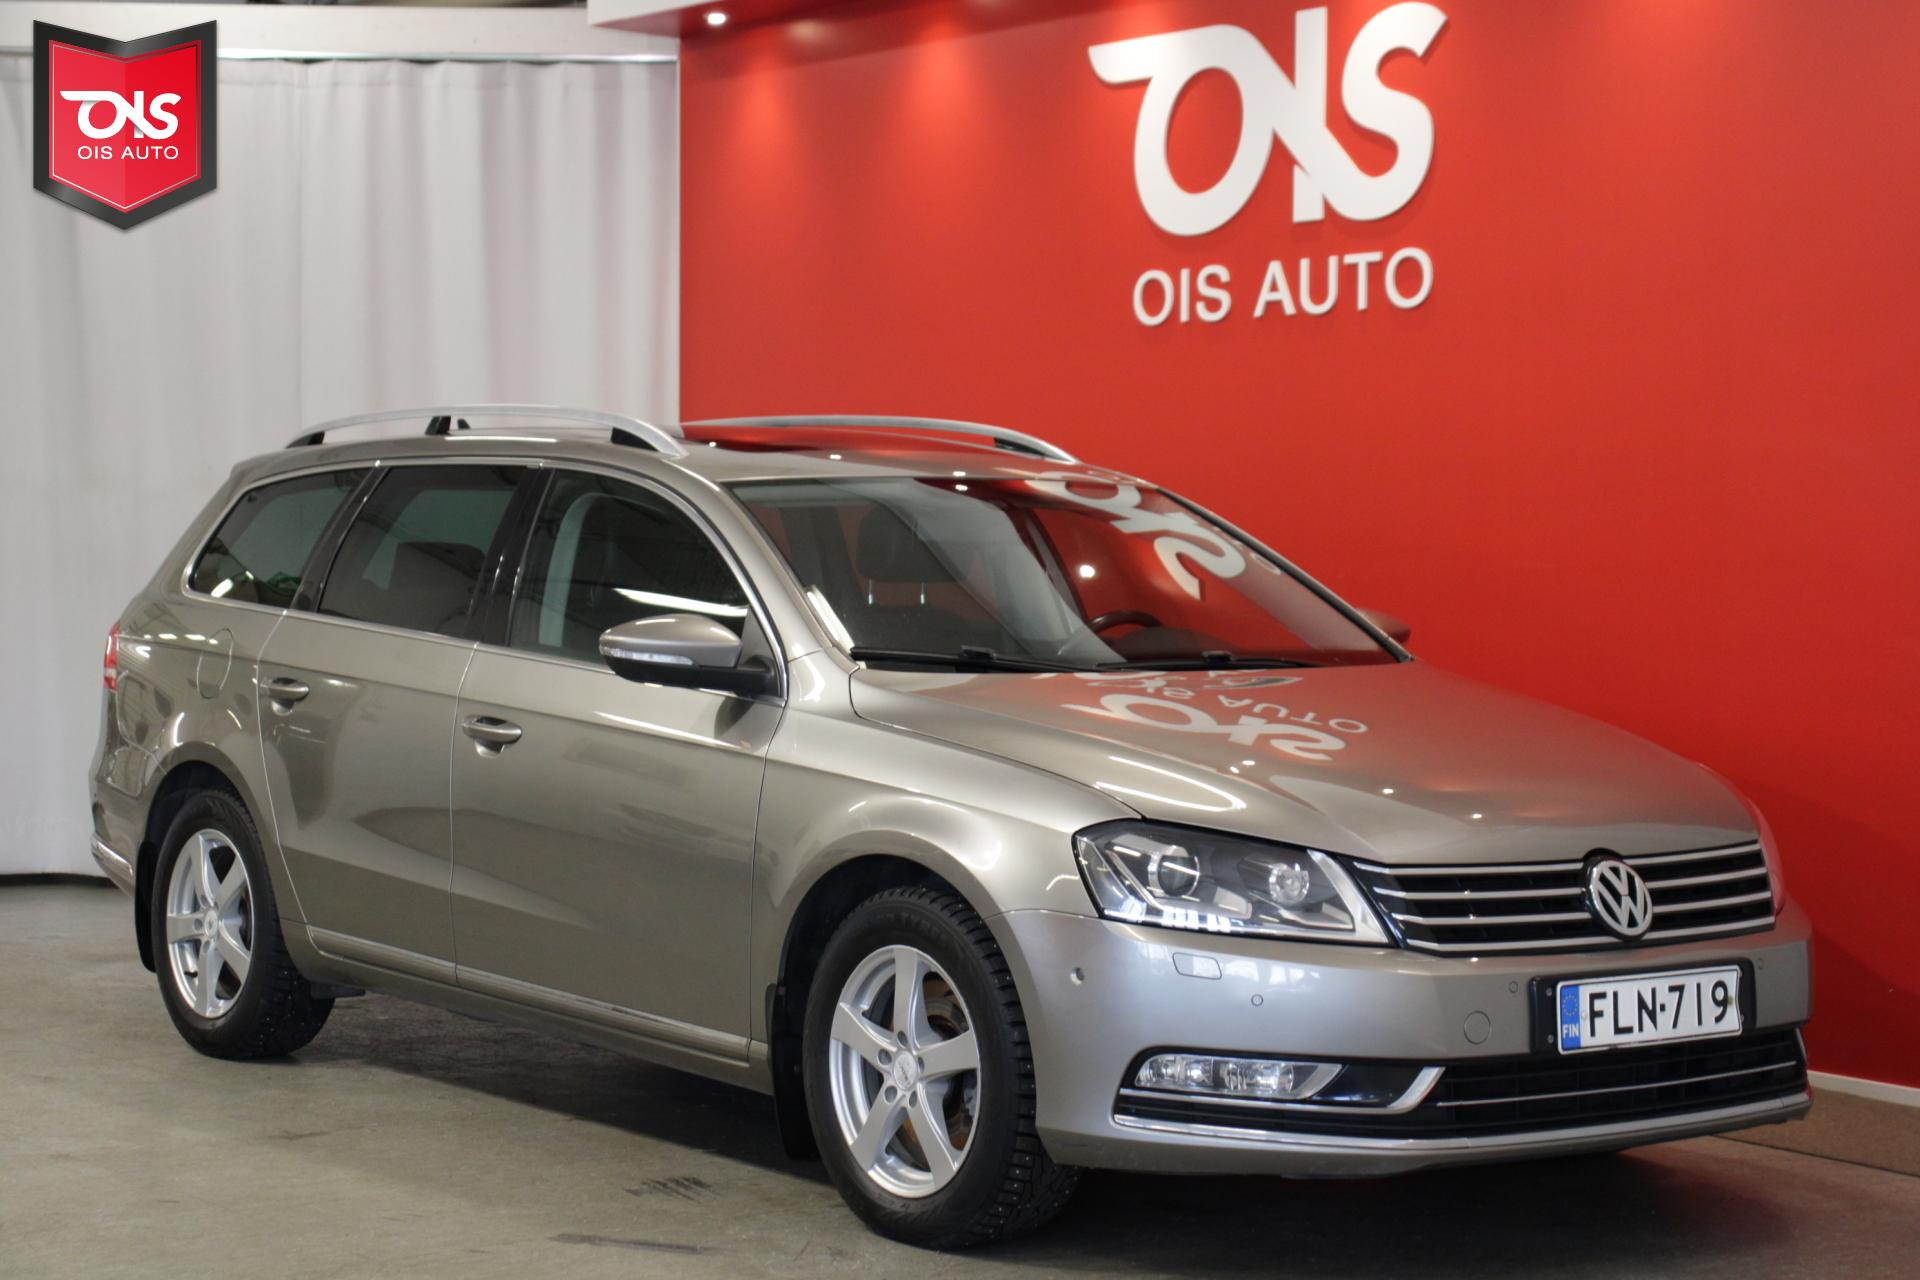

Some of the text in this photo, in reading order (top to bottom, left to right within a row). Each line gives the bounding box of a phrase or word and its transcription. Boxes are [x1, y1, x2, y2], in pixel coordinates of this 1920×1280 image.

[1132, 246, 1434, 327] OIS AUTO
[1562, 1024, 1579, 1038] FIN
[1588, 980, 1729, 1038] FLN-719
